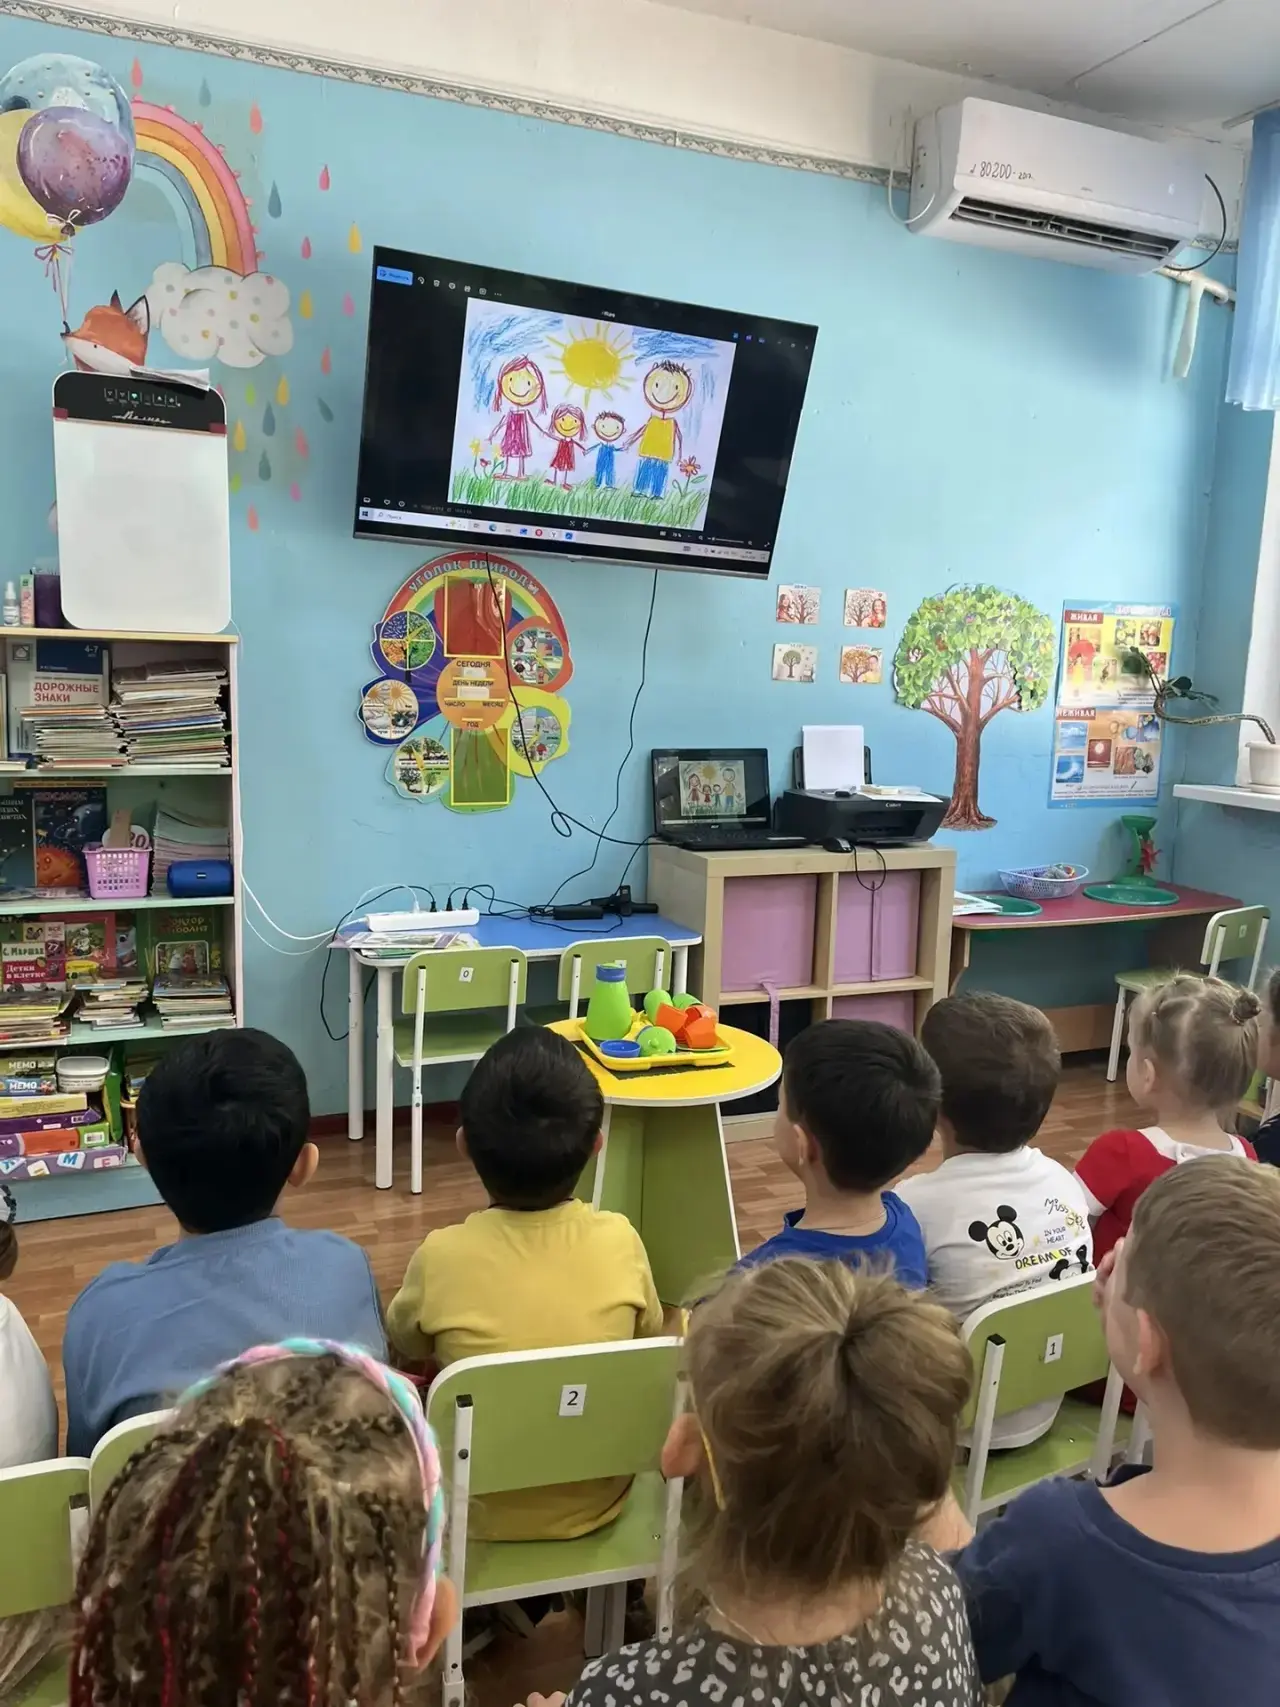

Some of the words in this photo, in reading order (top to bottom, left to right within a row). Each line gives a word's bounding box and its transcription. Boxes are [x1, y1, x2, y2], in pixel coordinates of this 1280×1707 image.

[408, 560, 462, 592] УГОЛОК
[469, 559, 540, 595] ПРИРОДЫ
[1070, 612, 1098, 621] ЖИВАЯ
[84, 644, 99, 653] 4-7
[456, 660, 491, 668] СЕГОДНЯ
[34, 682, 99, 693] ДОРОЖНЫЕ
[34, 692, 71, 703] ЗНАКИ
[6, 964, 36, 974] Детки
[1052, 1226, 1066, 1235] YOUR
[1046, 1234, 1065, 1244] HEART
[1015, 1251, 1058, 1270] DREAM
[1059, 1246, 1073, 1258] OF
[1049, 1342, 1056, 1356] 1
[567, 1390, 579, 1406] 2
